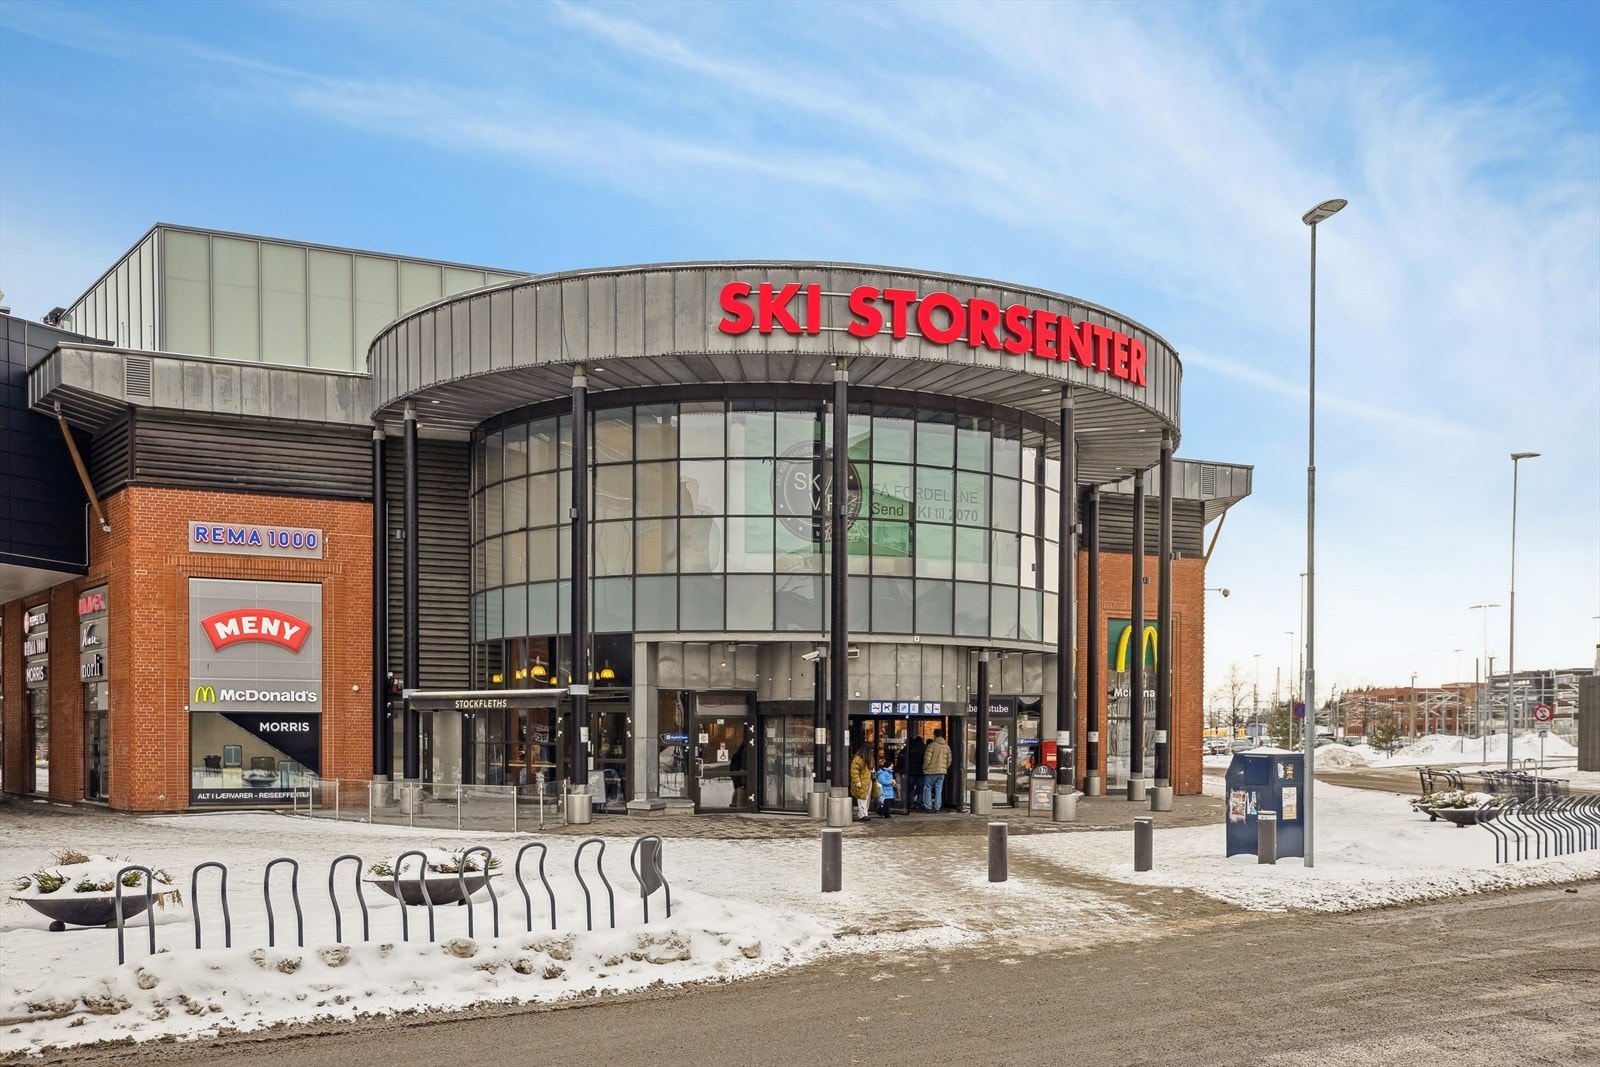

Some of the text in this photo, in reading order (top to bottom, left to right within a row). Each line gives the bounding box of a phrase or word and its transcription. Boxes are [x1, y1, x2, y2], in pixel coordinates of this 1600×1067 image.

[718, 281, 1147, 388] SKI STORSENTER
[872, 501, 904, 517] Send
[935, 507, 945, 519] til
[194, 525, 318, 549] REMA 1000
[214, 616, 301, 640] MENY
[81, 654, 100, 677] norli
[26, 666, 44, 682] MORRIS
[219, 689, 318, 702] McDonald's
[455, 699, 507, 708] STOCKFLETHS
[967, 704, 1009, 713] bastube
[259, 722, 310, 732] MORRIS
[215, 791, 254, 799] LÆRVARER
